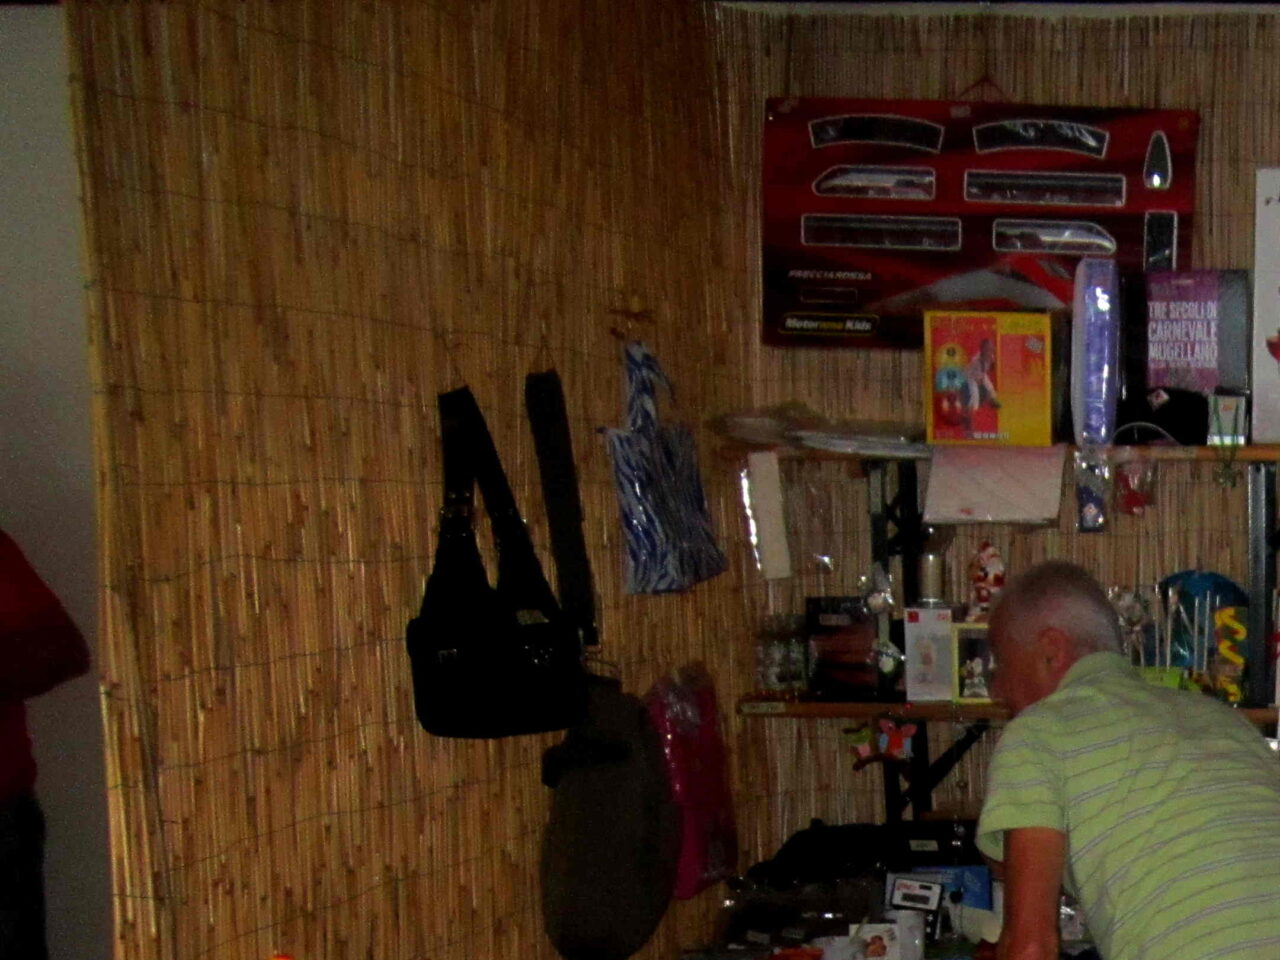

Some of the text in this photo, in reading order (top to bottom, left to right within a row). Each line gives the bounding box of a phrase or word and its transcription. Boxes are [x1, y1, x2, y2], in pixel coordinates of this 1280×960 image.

[1147, 301, 1168, 319] TRE
[845, 319, 872, 331] Kids
[1147, 320, 1218, 341] CARNEVALE
[1147, 341, 1218, 361] MUGELLANO
